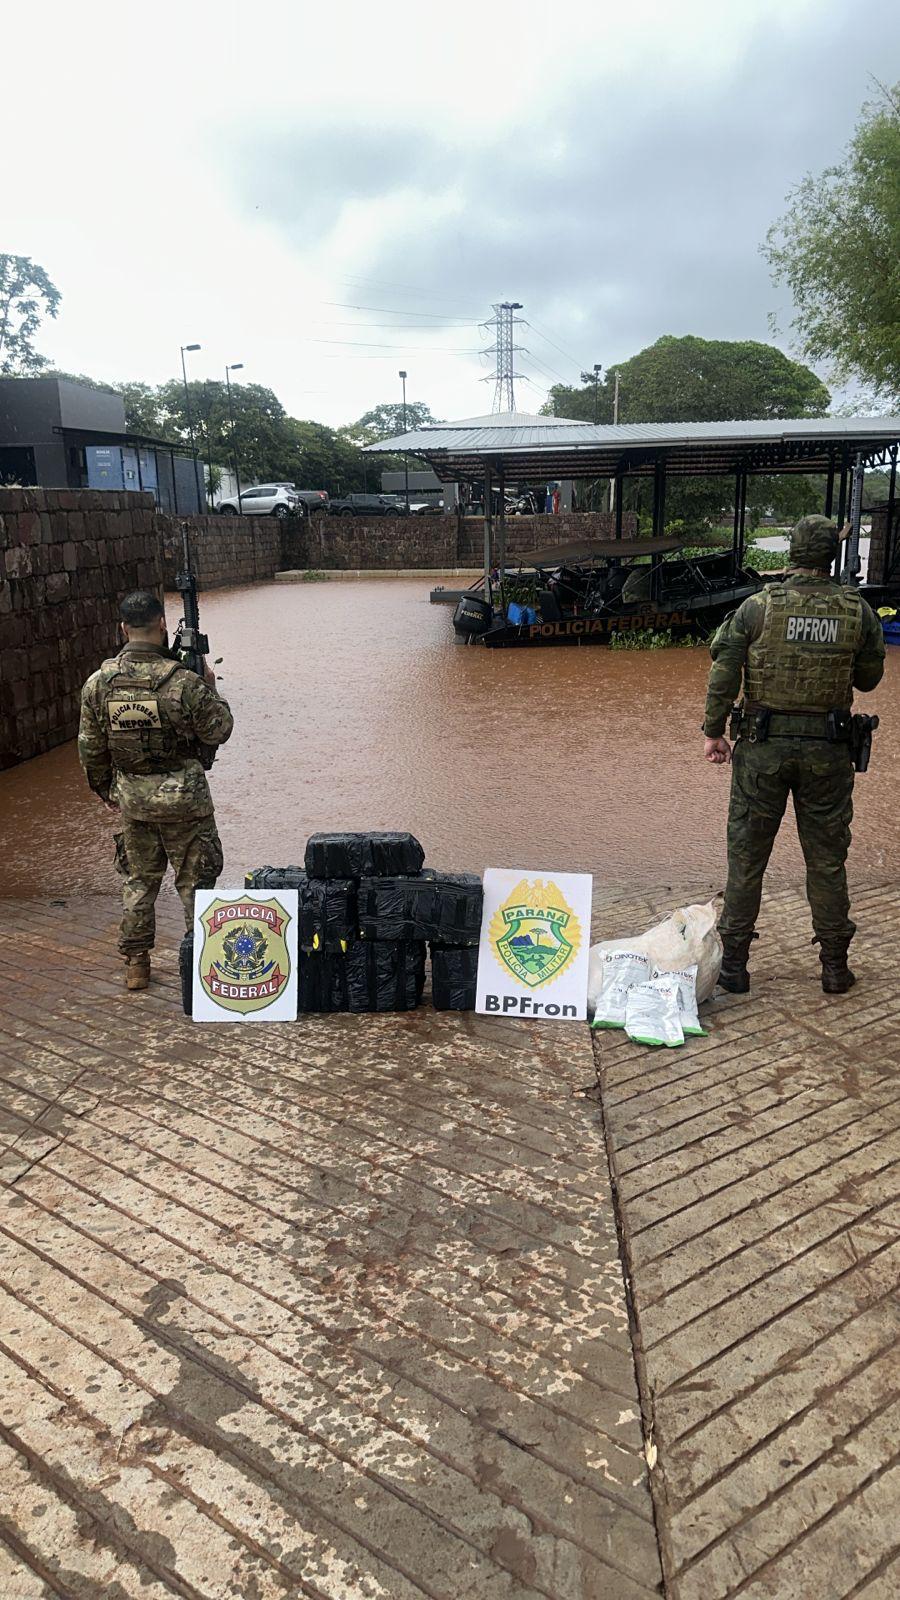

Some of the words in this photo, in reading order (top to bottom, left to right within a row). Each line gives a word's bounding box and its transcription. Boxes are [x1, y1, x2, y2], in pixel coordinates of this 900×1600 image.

[607, 610, 692, 632] FEDERAL
[786, 616, 839, 643] BPFRON
[118, 718, 153, 729] NEPOM
[132, 703, 158, 723] FEDERAL
[537, 947, 569, 980] MILITAR
[211, 981, 277, 998] FEDERAL
[485, 994, 577, 1017] BPFron
